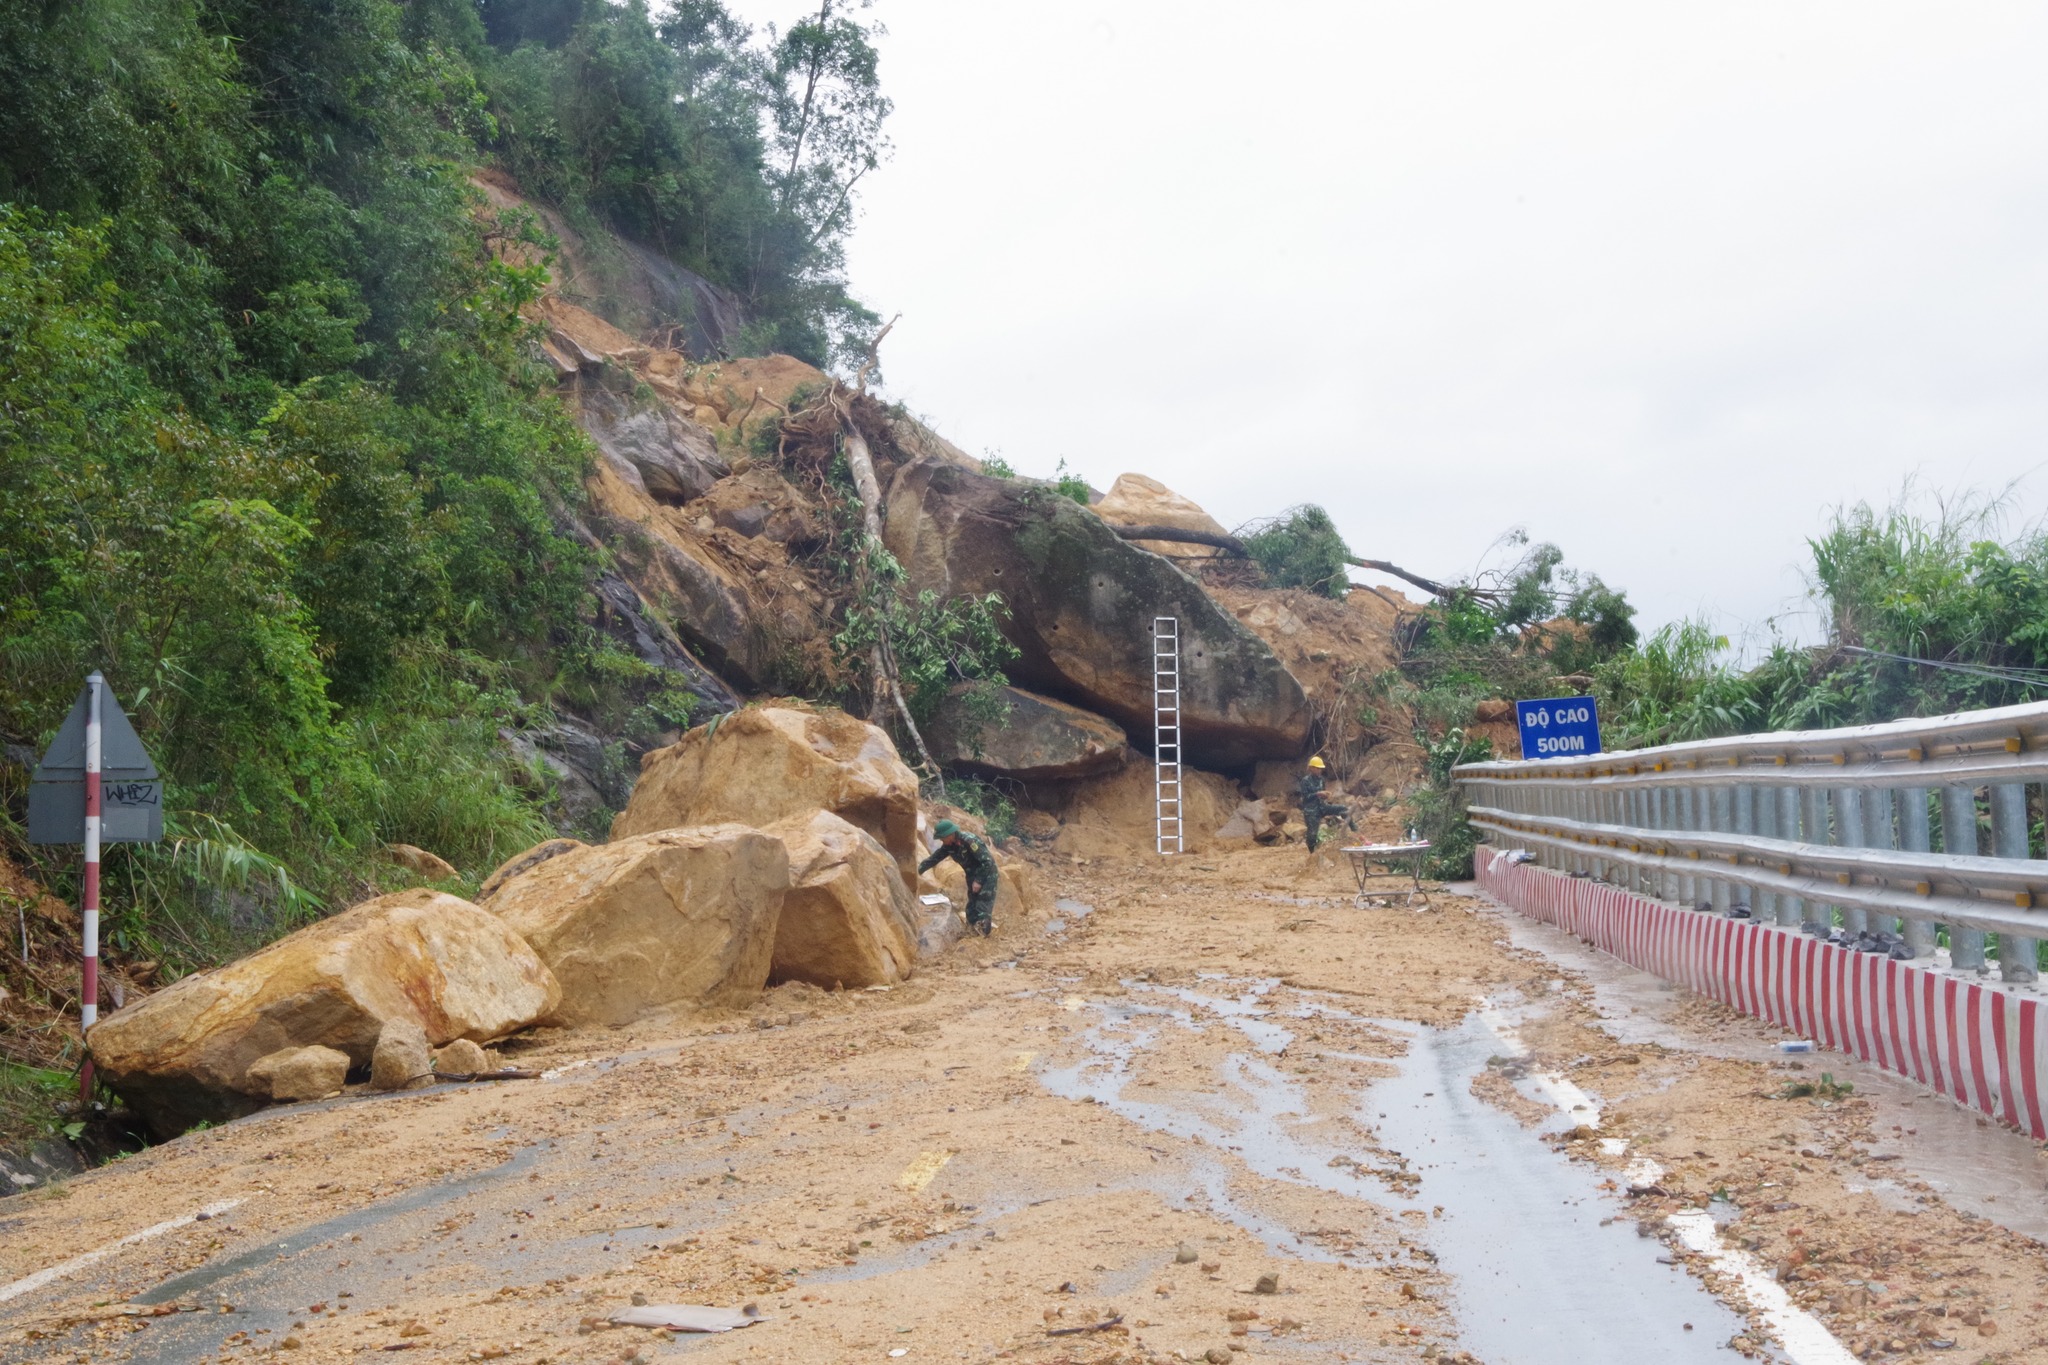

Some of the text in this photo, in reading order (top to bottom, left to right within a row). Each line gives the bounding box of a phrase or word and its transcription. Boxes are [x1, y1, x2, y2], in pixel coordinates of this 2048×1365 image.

[1525, 707, 1589, 729] ĐỘ CAO
[1537, 735, 1585, 753] 500M
